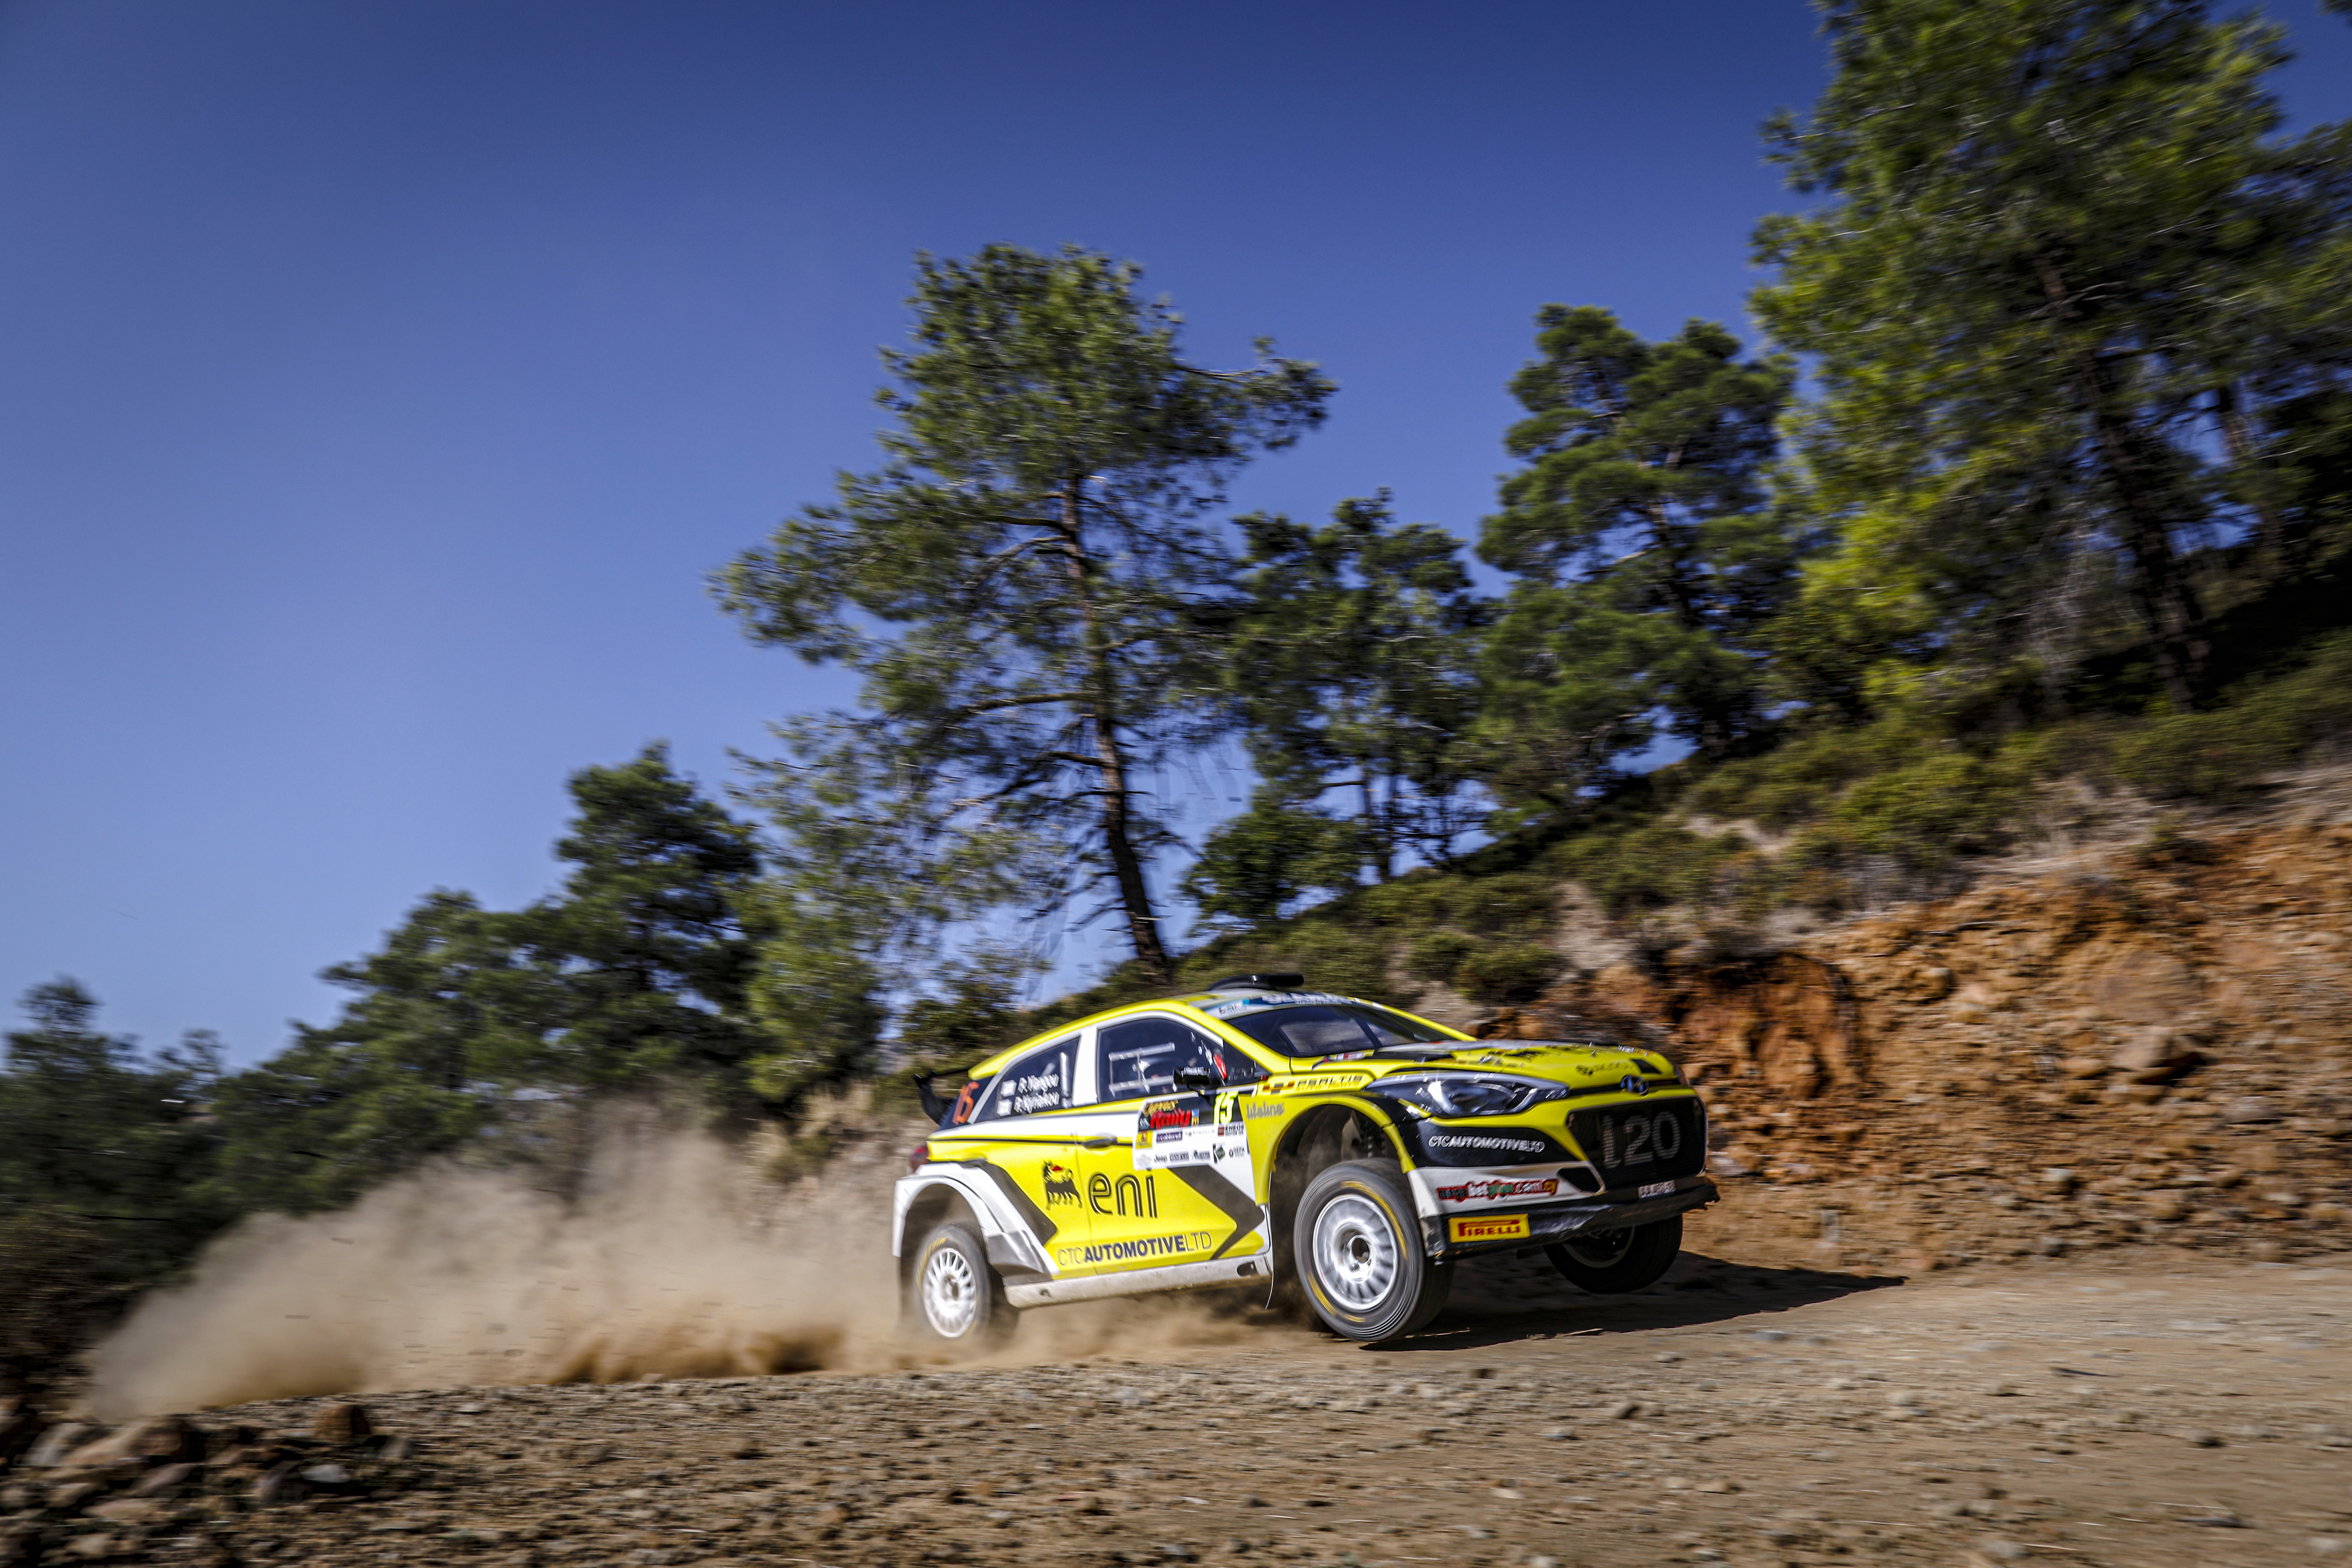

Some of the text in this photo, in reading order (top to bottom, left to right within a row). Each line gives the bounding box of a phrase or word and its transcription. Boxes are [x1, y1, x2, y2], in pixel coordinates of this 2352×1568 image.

[1150, 1107, 1191, 1130] Rally
[1214, 1091, 1239, 1125] 15
[1153, 1154, 1168, 1163] Jeep
[1089, 1167, 1158, 1219] eni
[1459, 1219, 1520, 1236] PIRELLI
